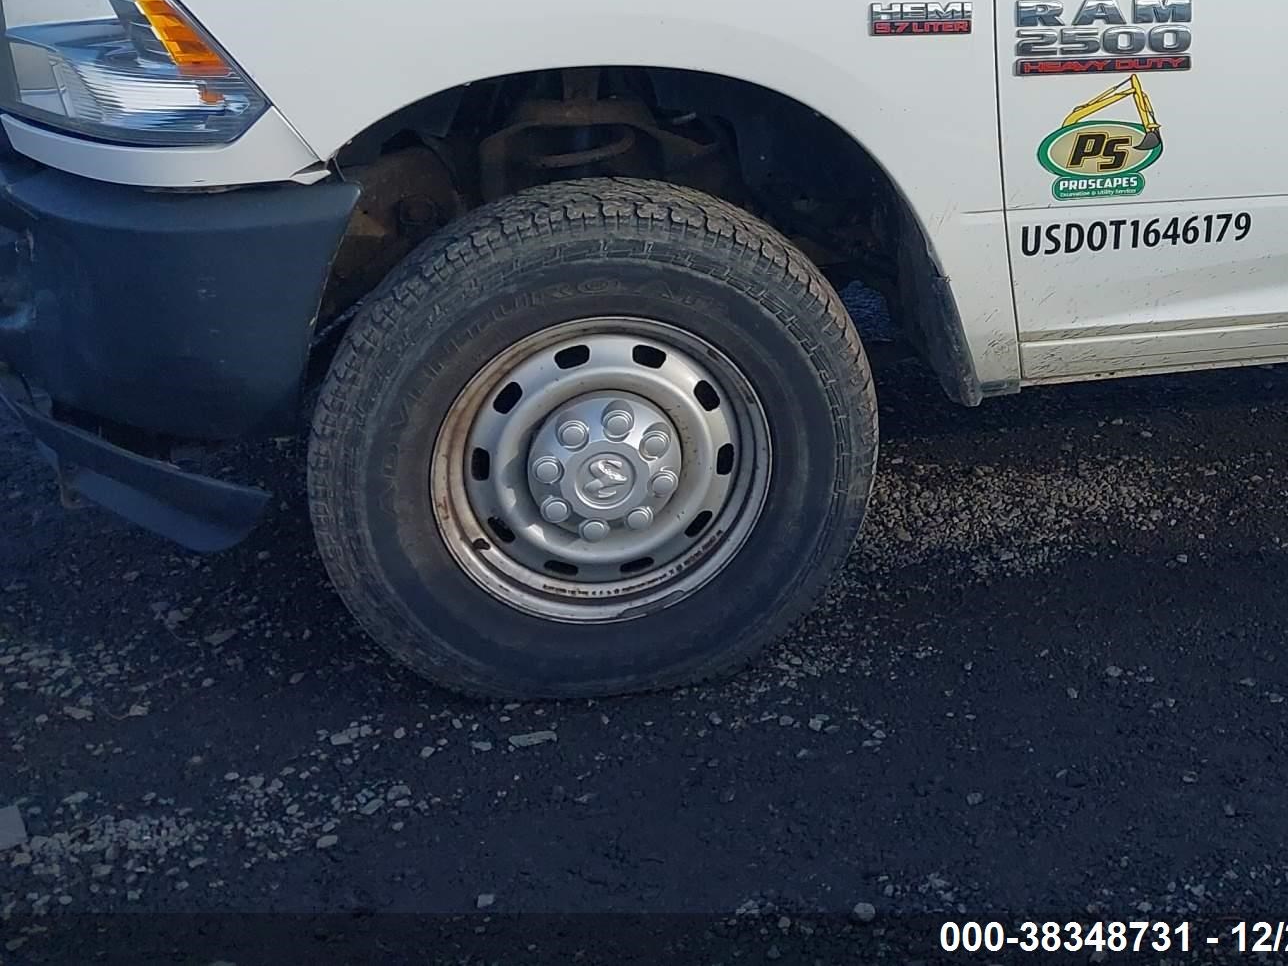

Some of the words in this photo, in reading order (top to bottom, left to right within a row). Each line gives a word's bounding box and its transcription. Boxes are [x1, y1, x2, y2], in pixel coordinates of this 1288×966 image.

[869, 1, 972, 20] HEMI
[875, 21, 909, 33] 5.7
[911, 20, 969, 32] LITER
[1015, 25, 1192, 56] 2500
[1023, 60, 1112, 74] HEAVY
[1115, 57, 1186, 71] DUTY
[1066, 131, 1133, 172] PS
[1059, 176, 1138, 191] PROSCAPES
[1021, 212, 1252, 257] USDOT1646179
